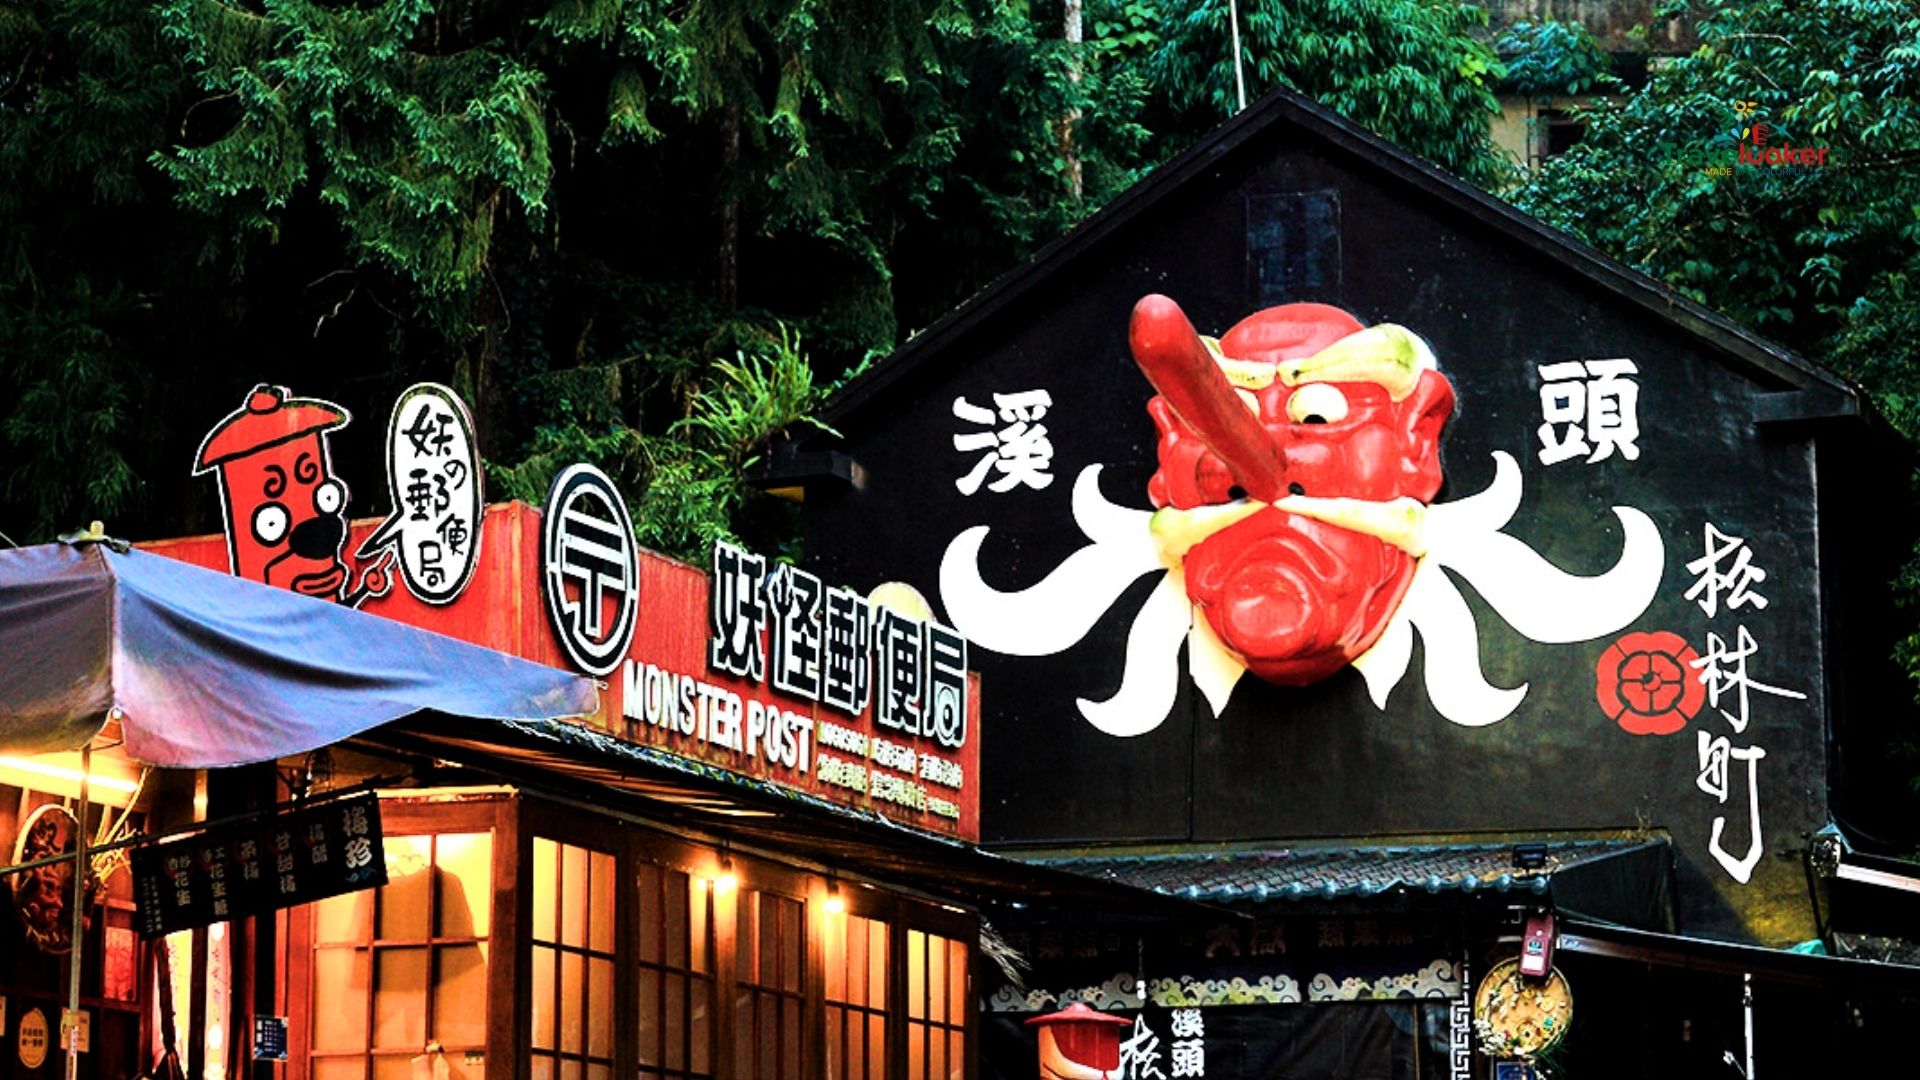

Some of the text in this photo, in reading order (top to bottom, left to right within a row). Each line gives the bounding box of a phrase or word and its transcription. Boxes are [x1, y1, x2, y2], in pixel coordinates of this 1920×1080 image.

[952, 358, 1640, 496] 溪 頭
[710, 538, 968, 748] 妖怪郵便局
[623, 658, 743, 751] MONSTER
[746, 699, 814, 773] POST
[1171, 1008, 1205, 1078] 溪頭
